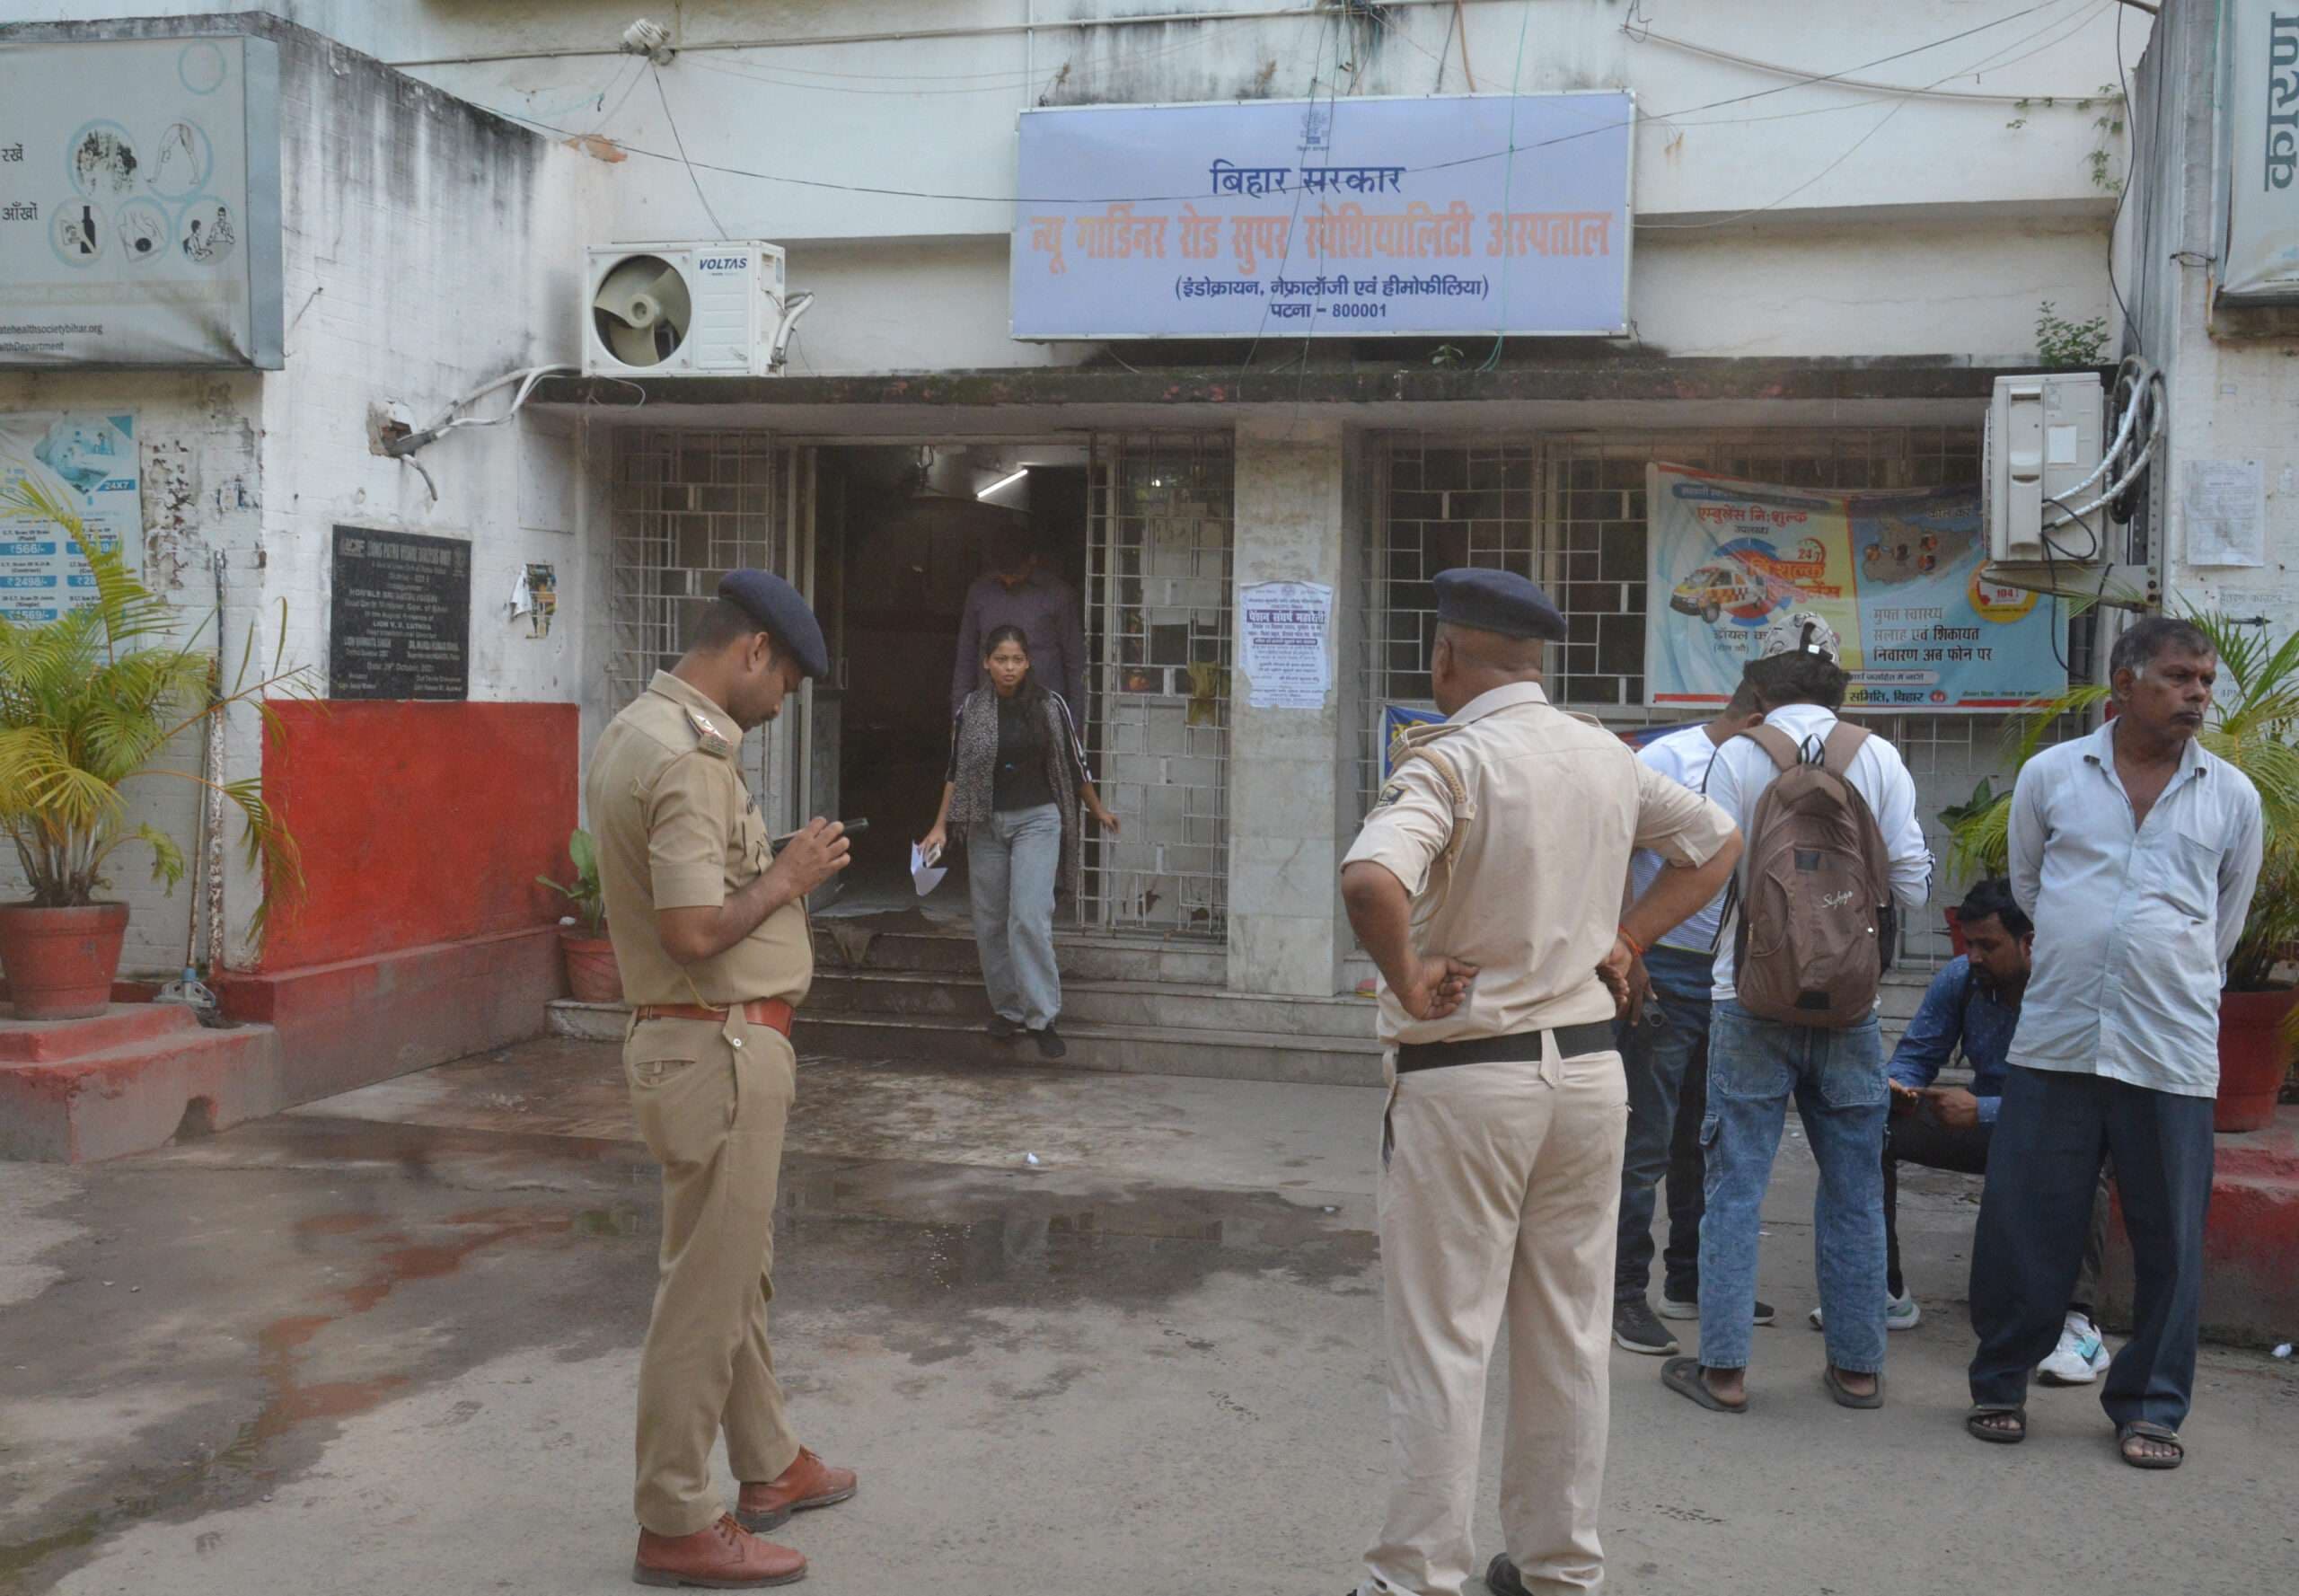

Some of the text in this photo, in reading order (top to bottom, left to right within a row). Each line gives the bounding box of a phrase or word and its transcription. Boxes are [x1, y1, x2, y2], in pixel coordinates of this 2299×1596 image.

[1209, 158, 1406, 198] बिहार सरकार
[2, 201, 38, 221] आँखों
[1030, 201, 1613, 275] न्यू गार्डिनर रोड सुपर स्पेशियालिटी अस्पताल
[699, 258, 748, 270] VOLTAS
[1353, 278, 1377, 295] एवं
[1271, 304, 1311, 319] पटना
[1333, 303, 1387, 318] 800001
[1912, 625, 1928, 640] एवं
[1933, 624, 1979, 640] शिकायत
[1873, 645, 1993, 662] निवारण अब फोन पर
[1849, 689, 1925, 703] समिति, बिहार
